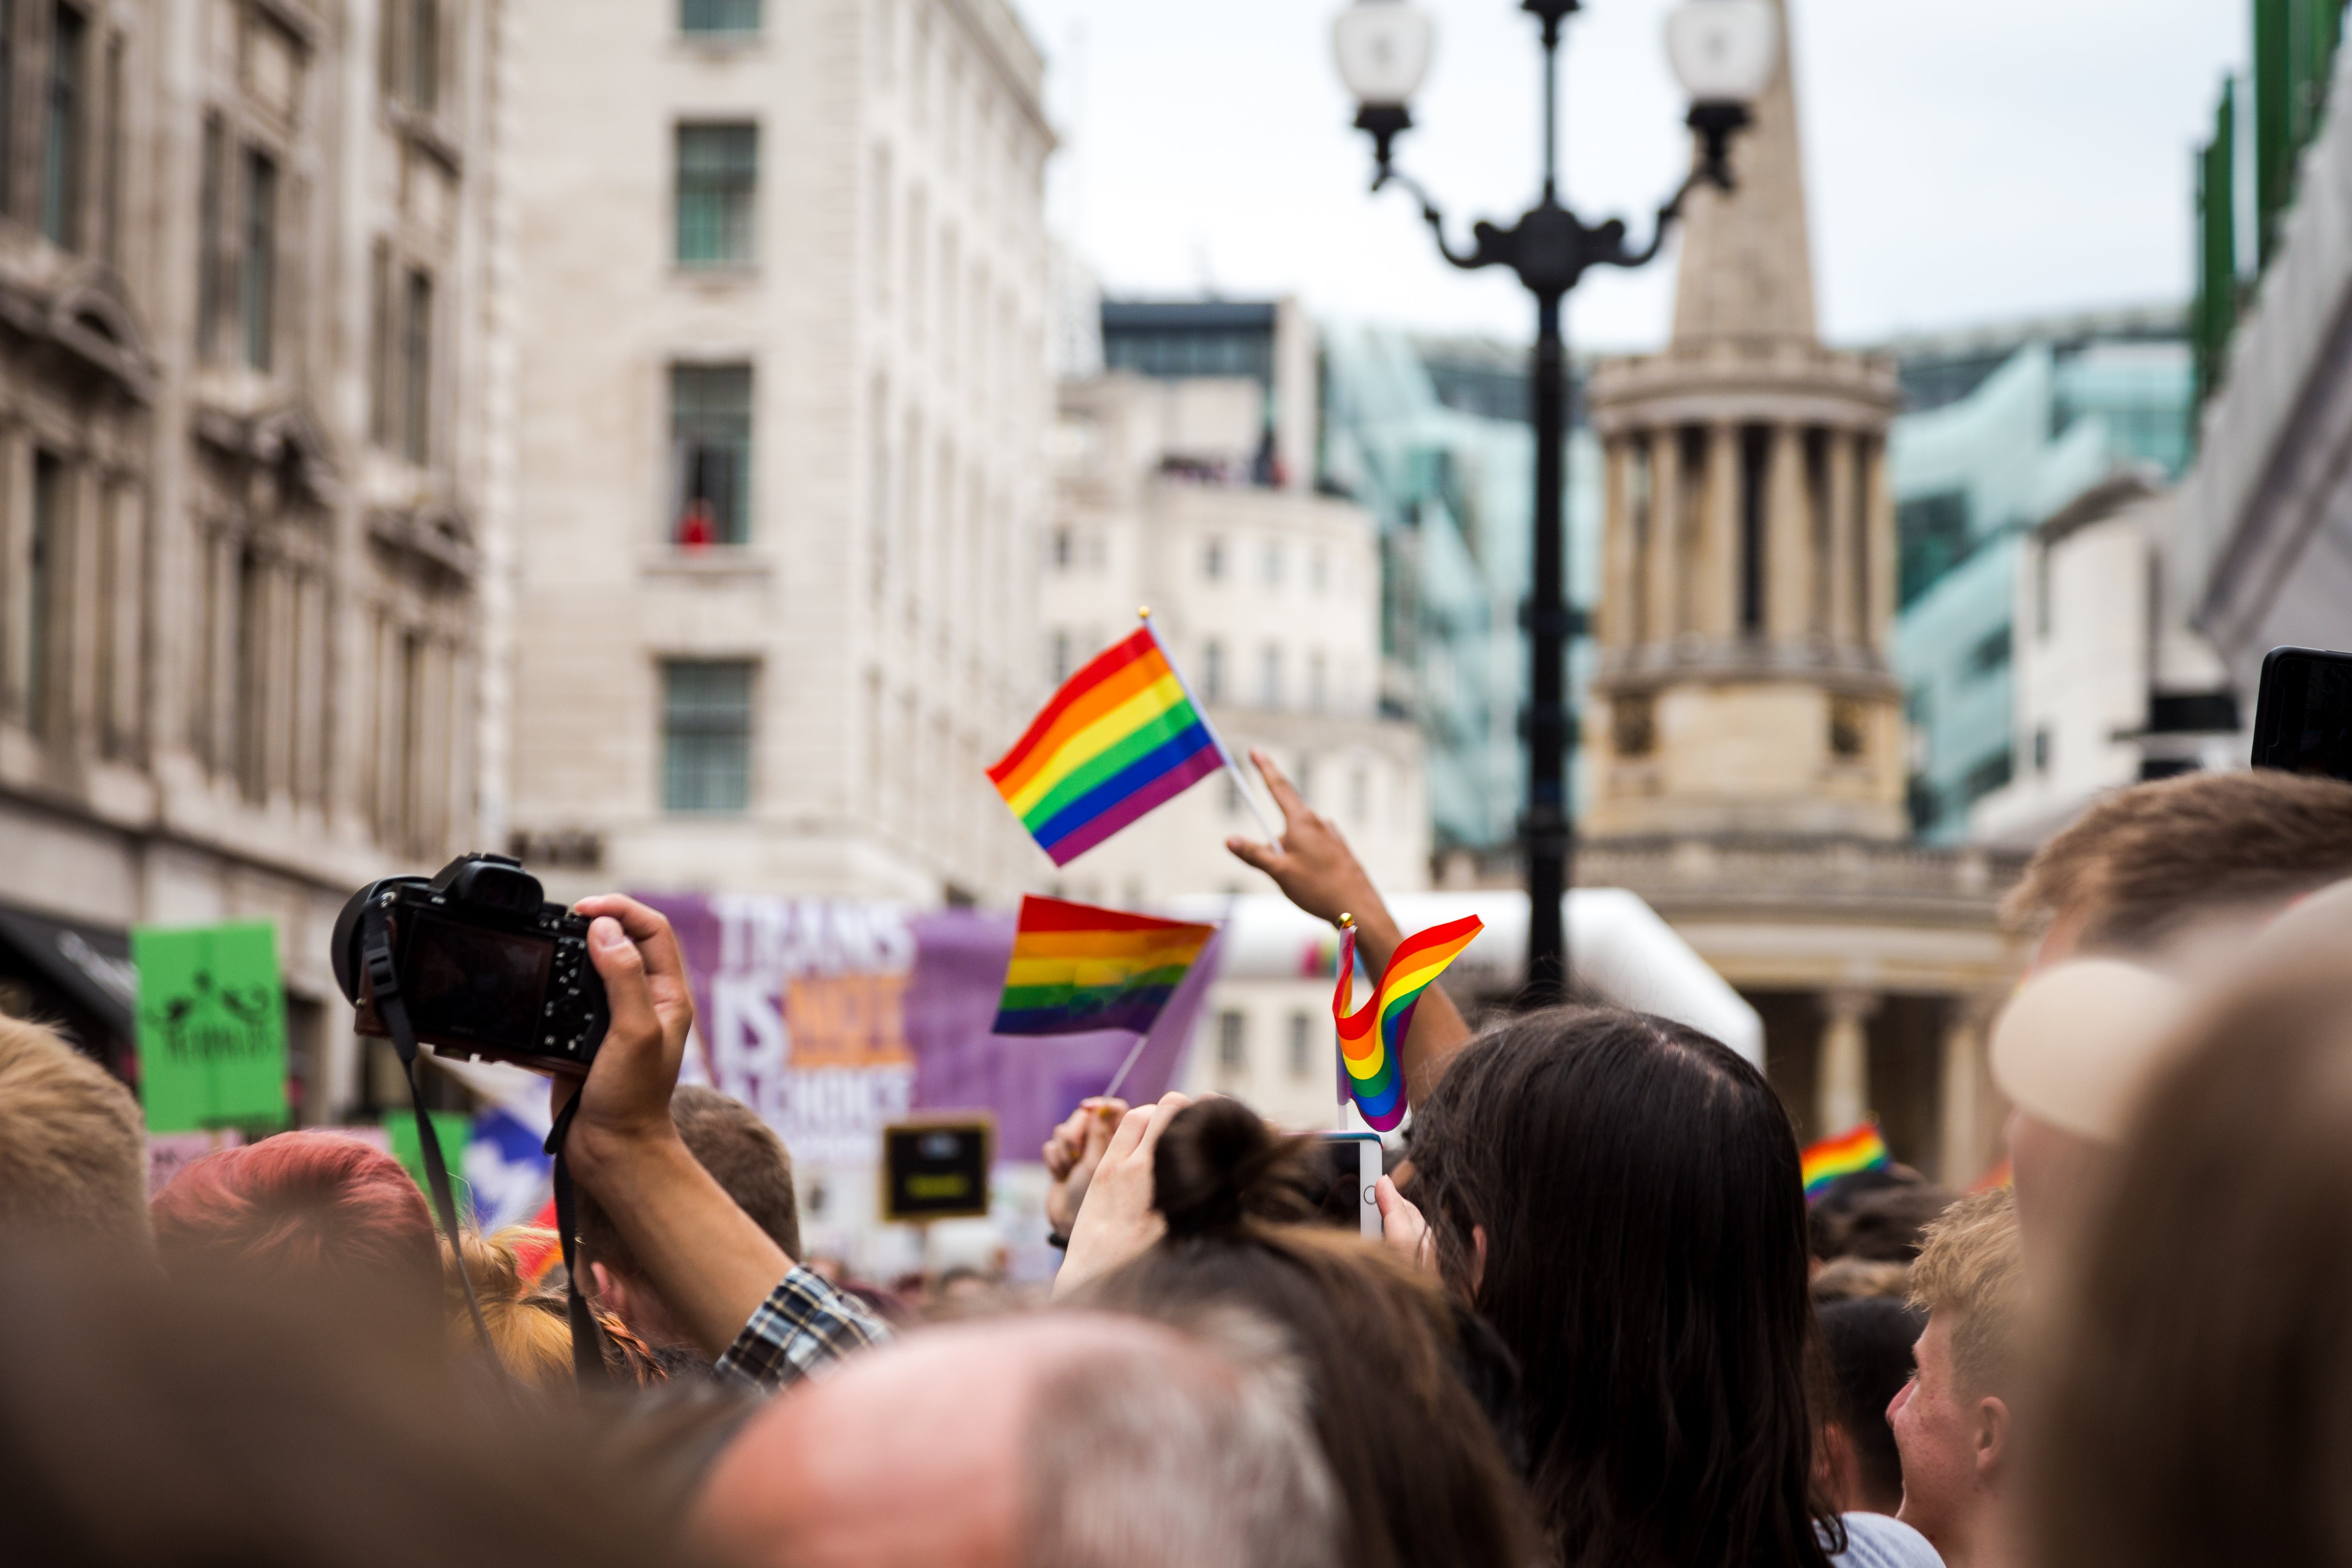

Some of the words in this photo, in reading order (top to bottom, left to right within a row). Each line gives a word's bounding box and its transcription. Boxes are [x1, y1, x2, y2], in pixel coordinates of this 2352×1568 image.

[713, 896, 916, 972] TRANS
[712, 977, 790, 1068] IS
[787, 972, 910, 1063] NOT
[760, 1069, 910, 1122] CHOICE
